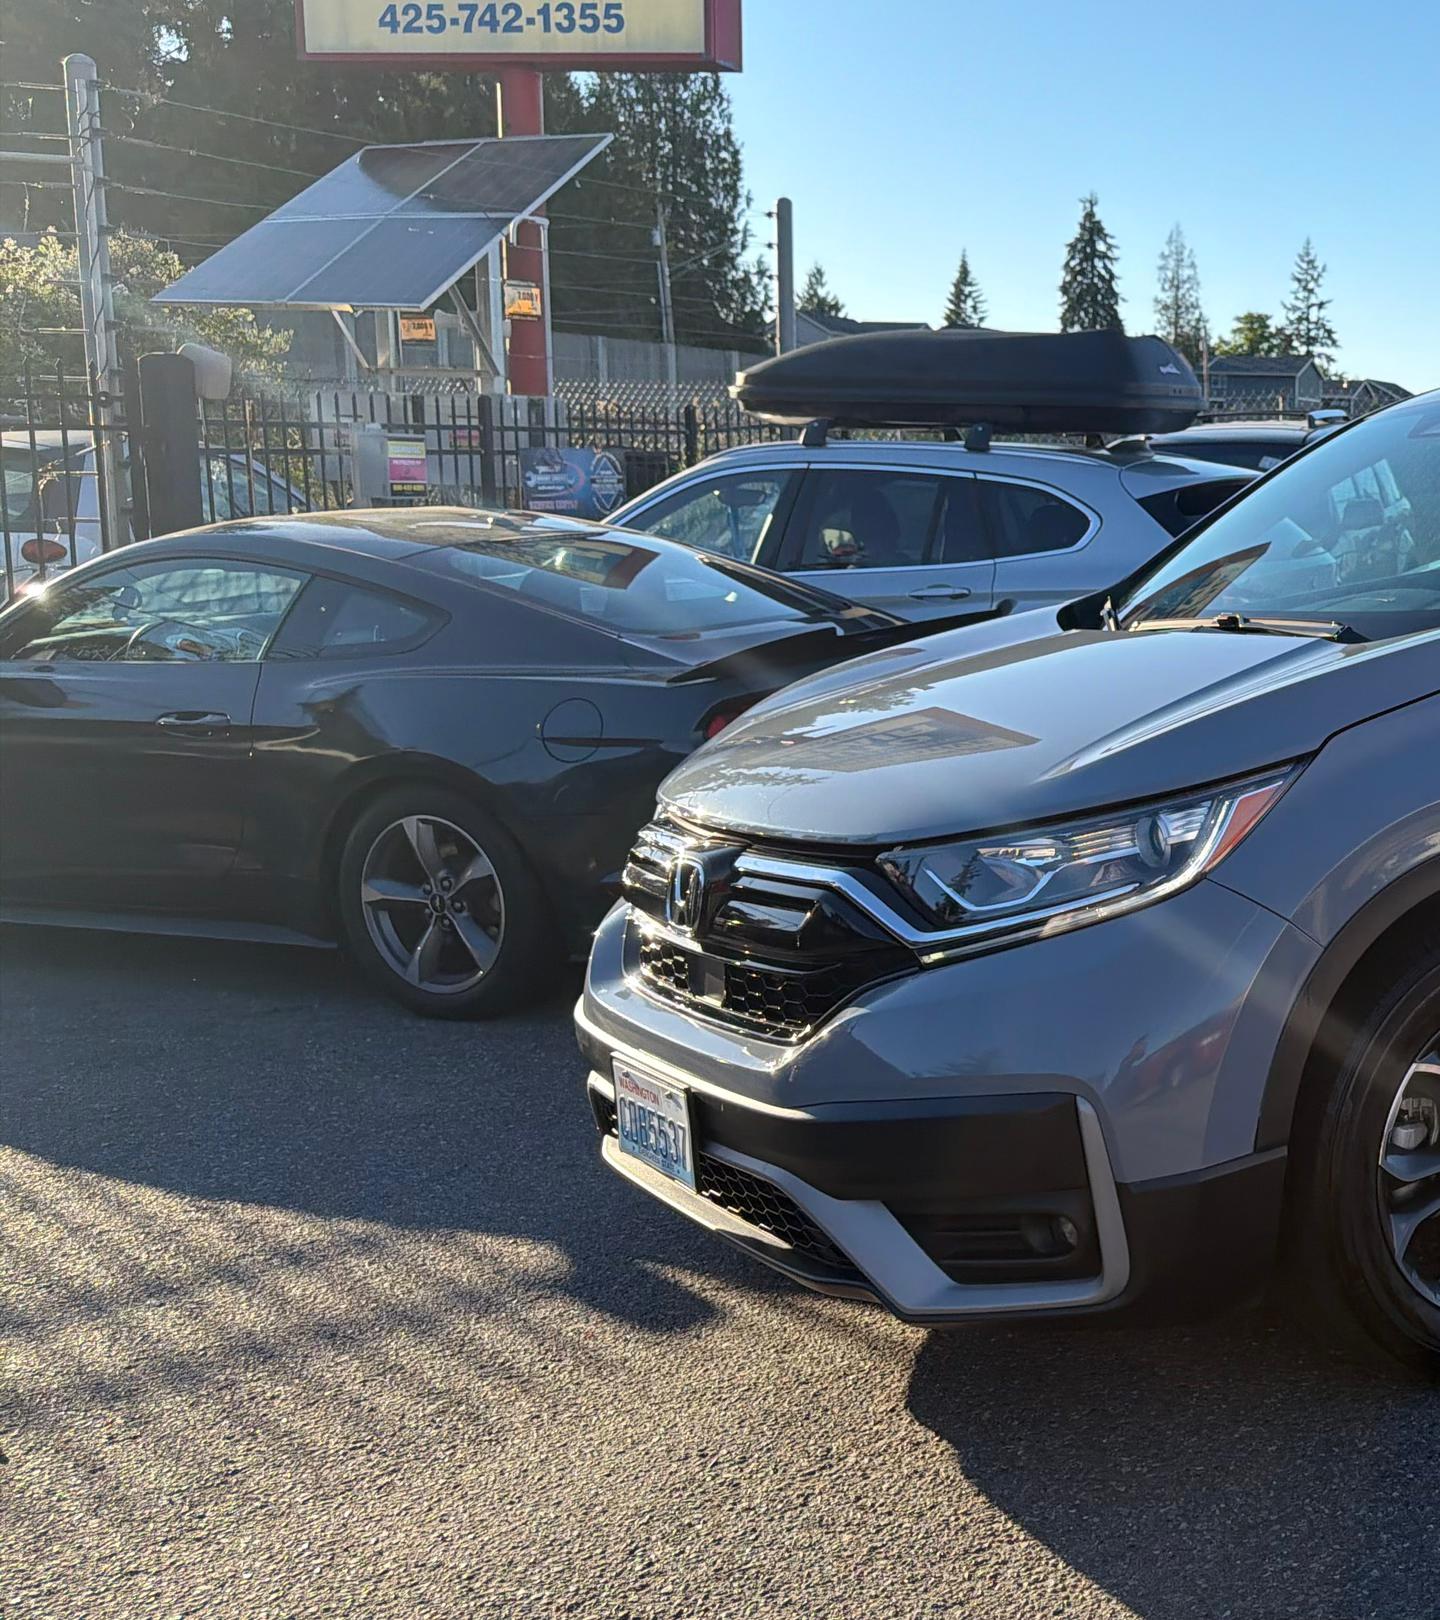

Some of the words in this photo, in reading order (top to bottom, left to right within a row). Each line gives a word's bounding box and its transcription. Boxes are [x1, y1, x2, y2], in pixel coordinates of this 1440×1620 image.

[378, 2, 626, 35] 425-742-1355
[619, 1077, 661, 1106] WASHINGTON
[619, 1095, 688, 1172] CDB5537
